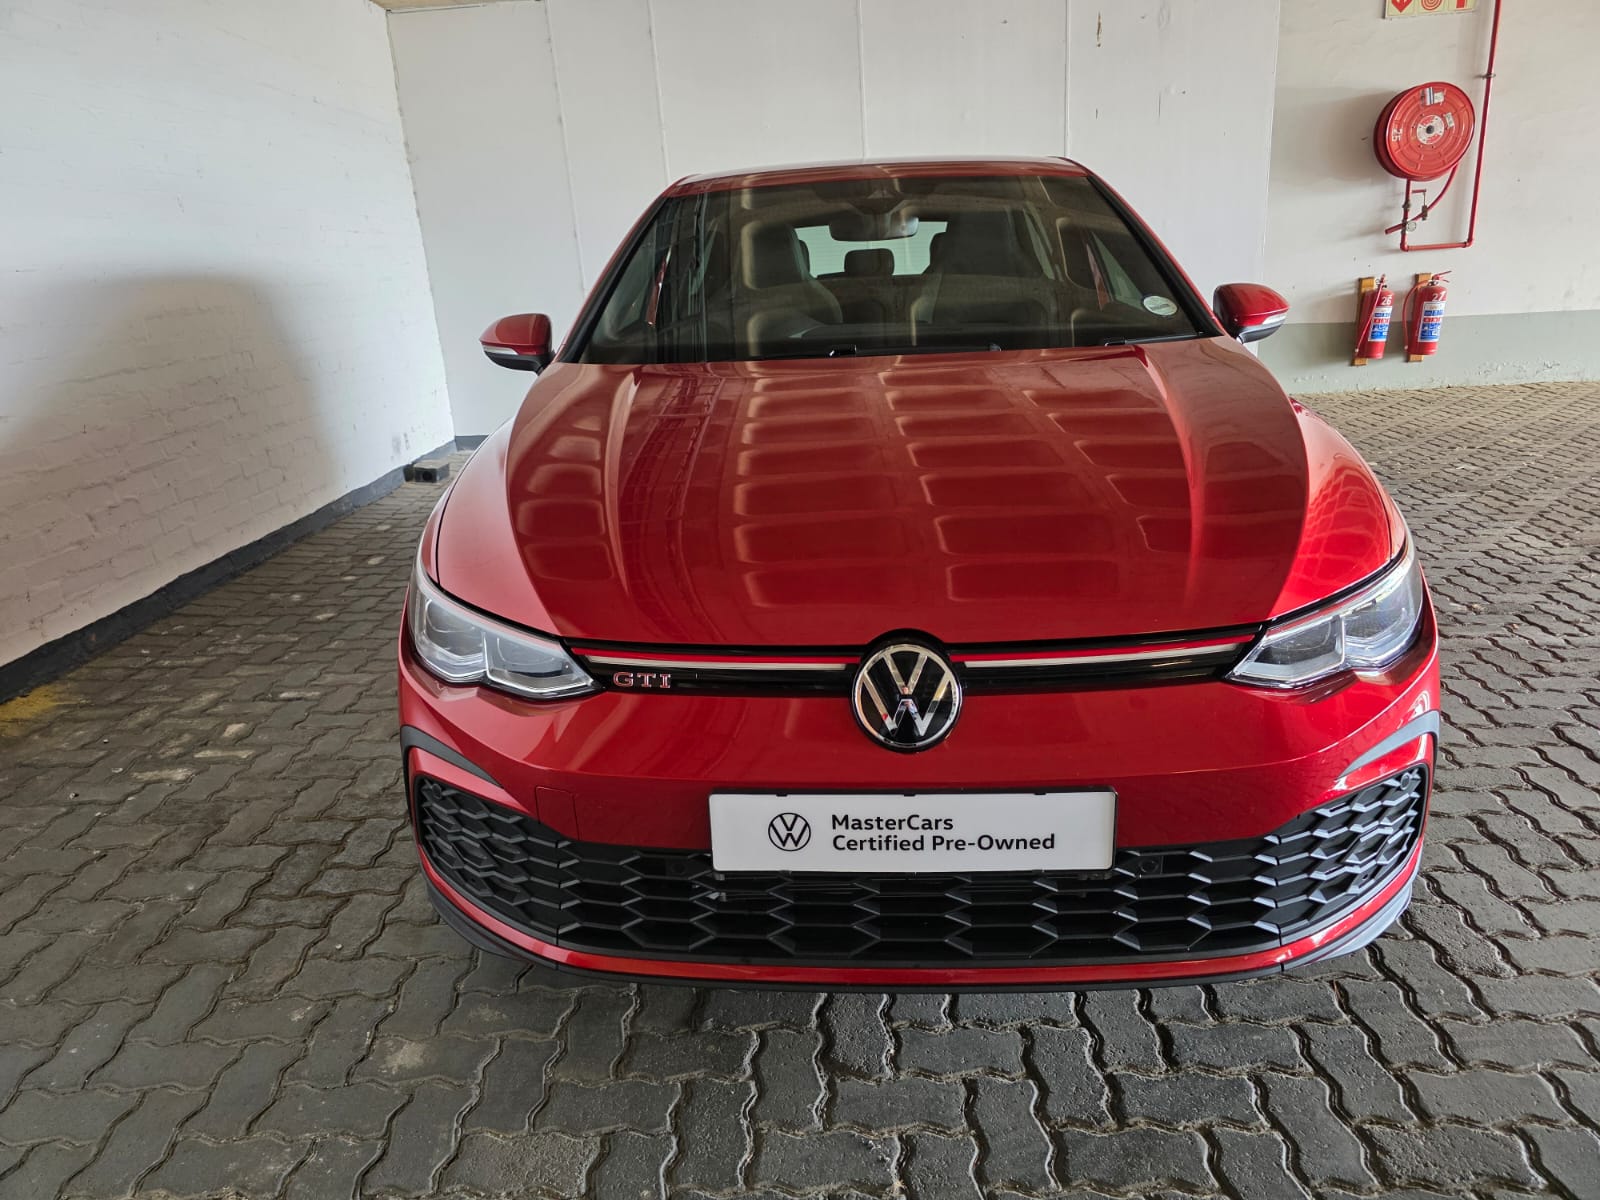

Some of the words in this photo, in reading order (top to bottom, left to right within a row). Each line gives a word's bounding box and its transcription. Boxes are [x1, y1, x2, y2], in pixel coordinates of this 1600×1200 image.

[612, 671, 672, 689] GTI
[831, 813, 954, 832] MasterCars
[832, 833, 925, 852] Certified
[931, 832, 1056, 851] Pre-Owned
